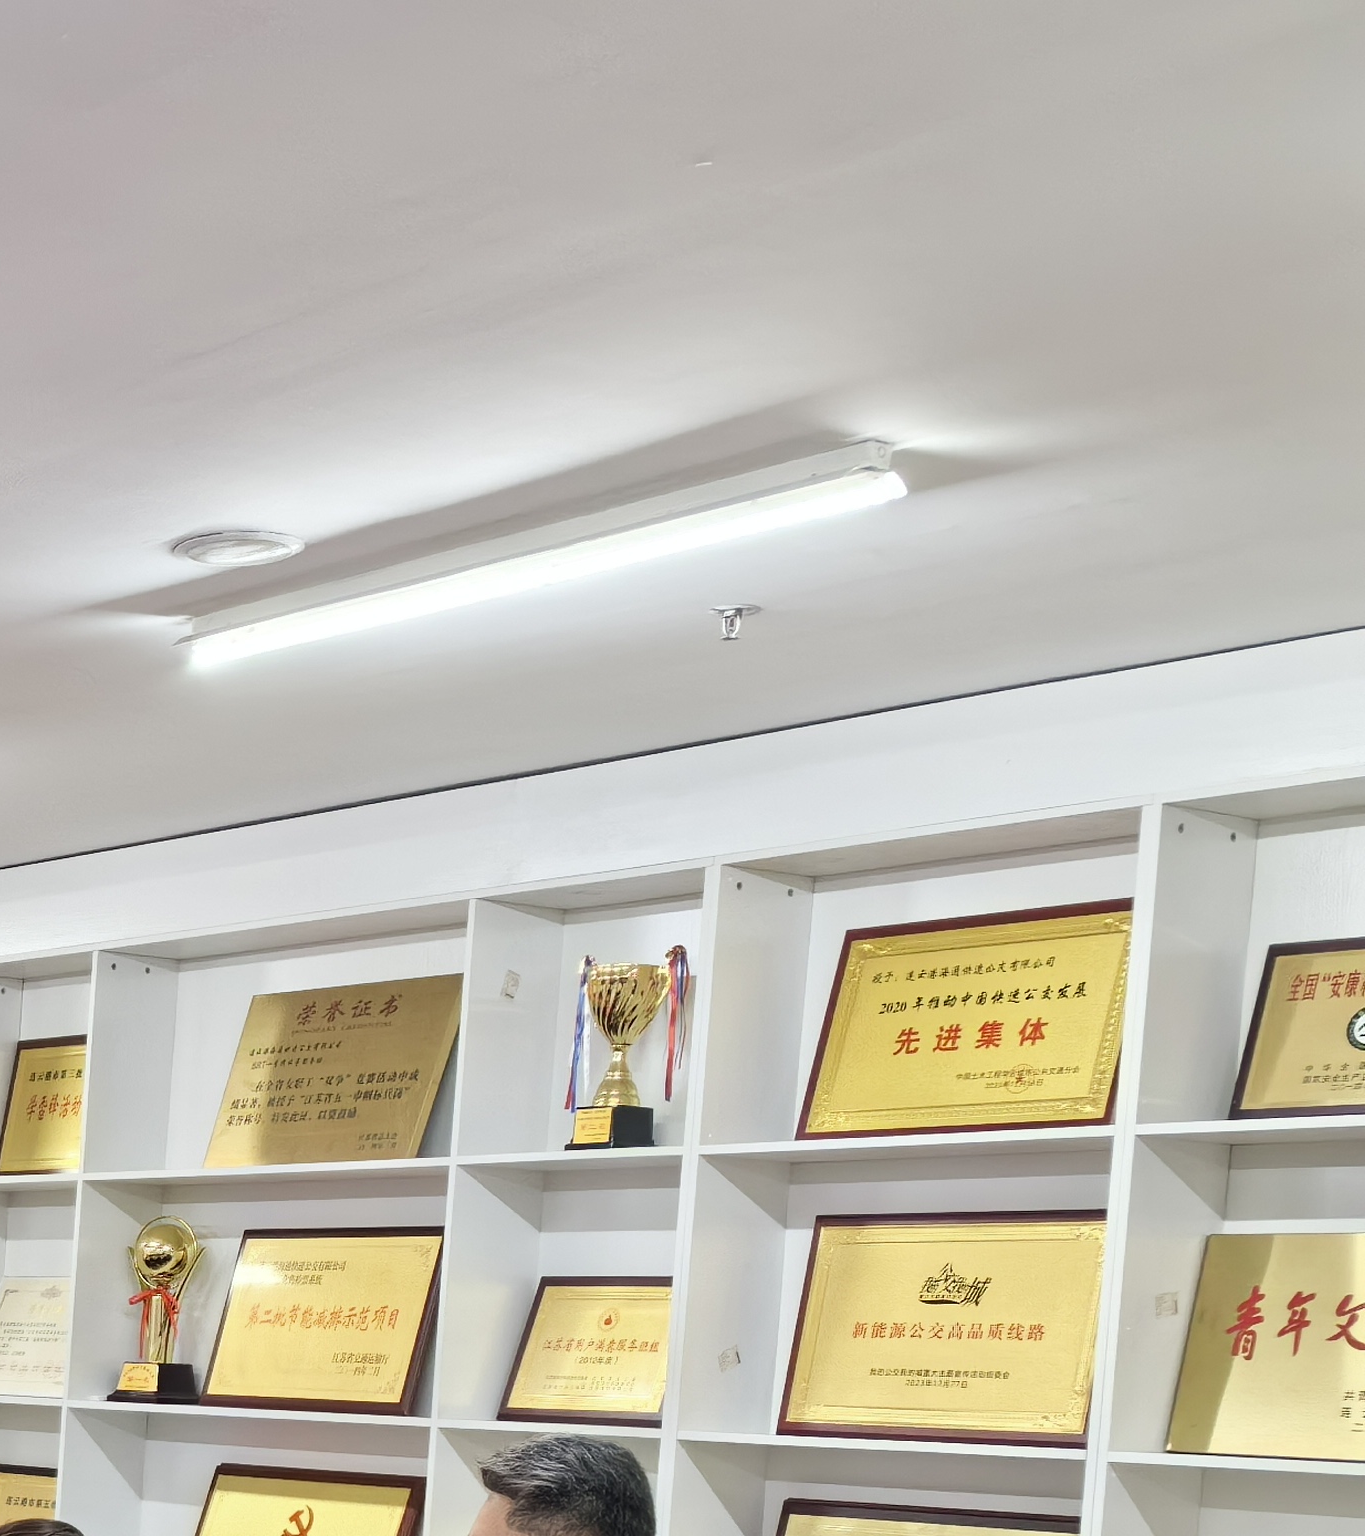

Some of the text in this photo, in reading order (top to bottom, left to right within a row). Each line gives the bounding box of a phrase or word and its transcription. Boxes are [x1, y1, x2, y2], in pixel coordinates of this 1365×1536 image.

[296, 994, 402, 1026] 荣誉证书
[892, 1017, 1049, 1055] 先进集体
[852, 1321, 1045, 1342] 新能源公交高品质线路
[1225, 1285, 1365, 1361] 青年文
